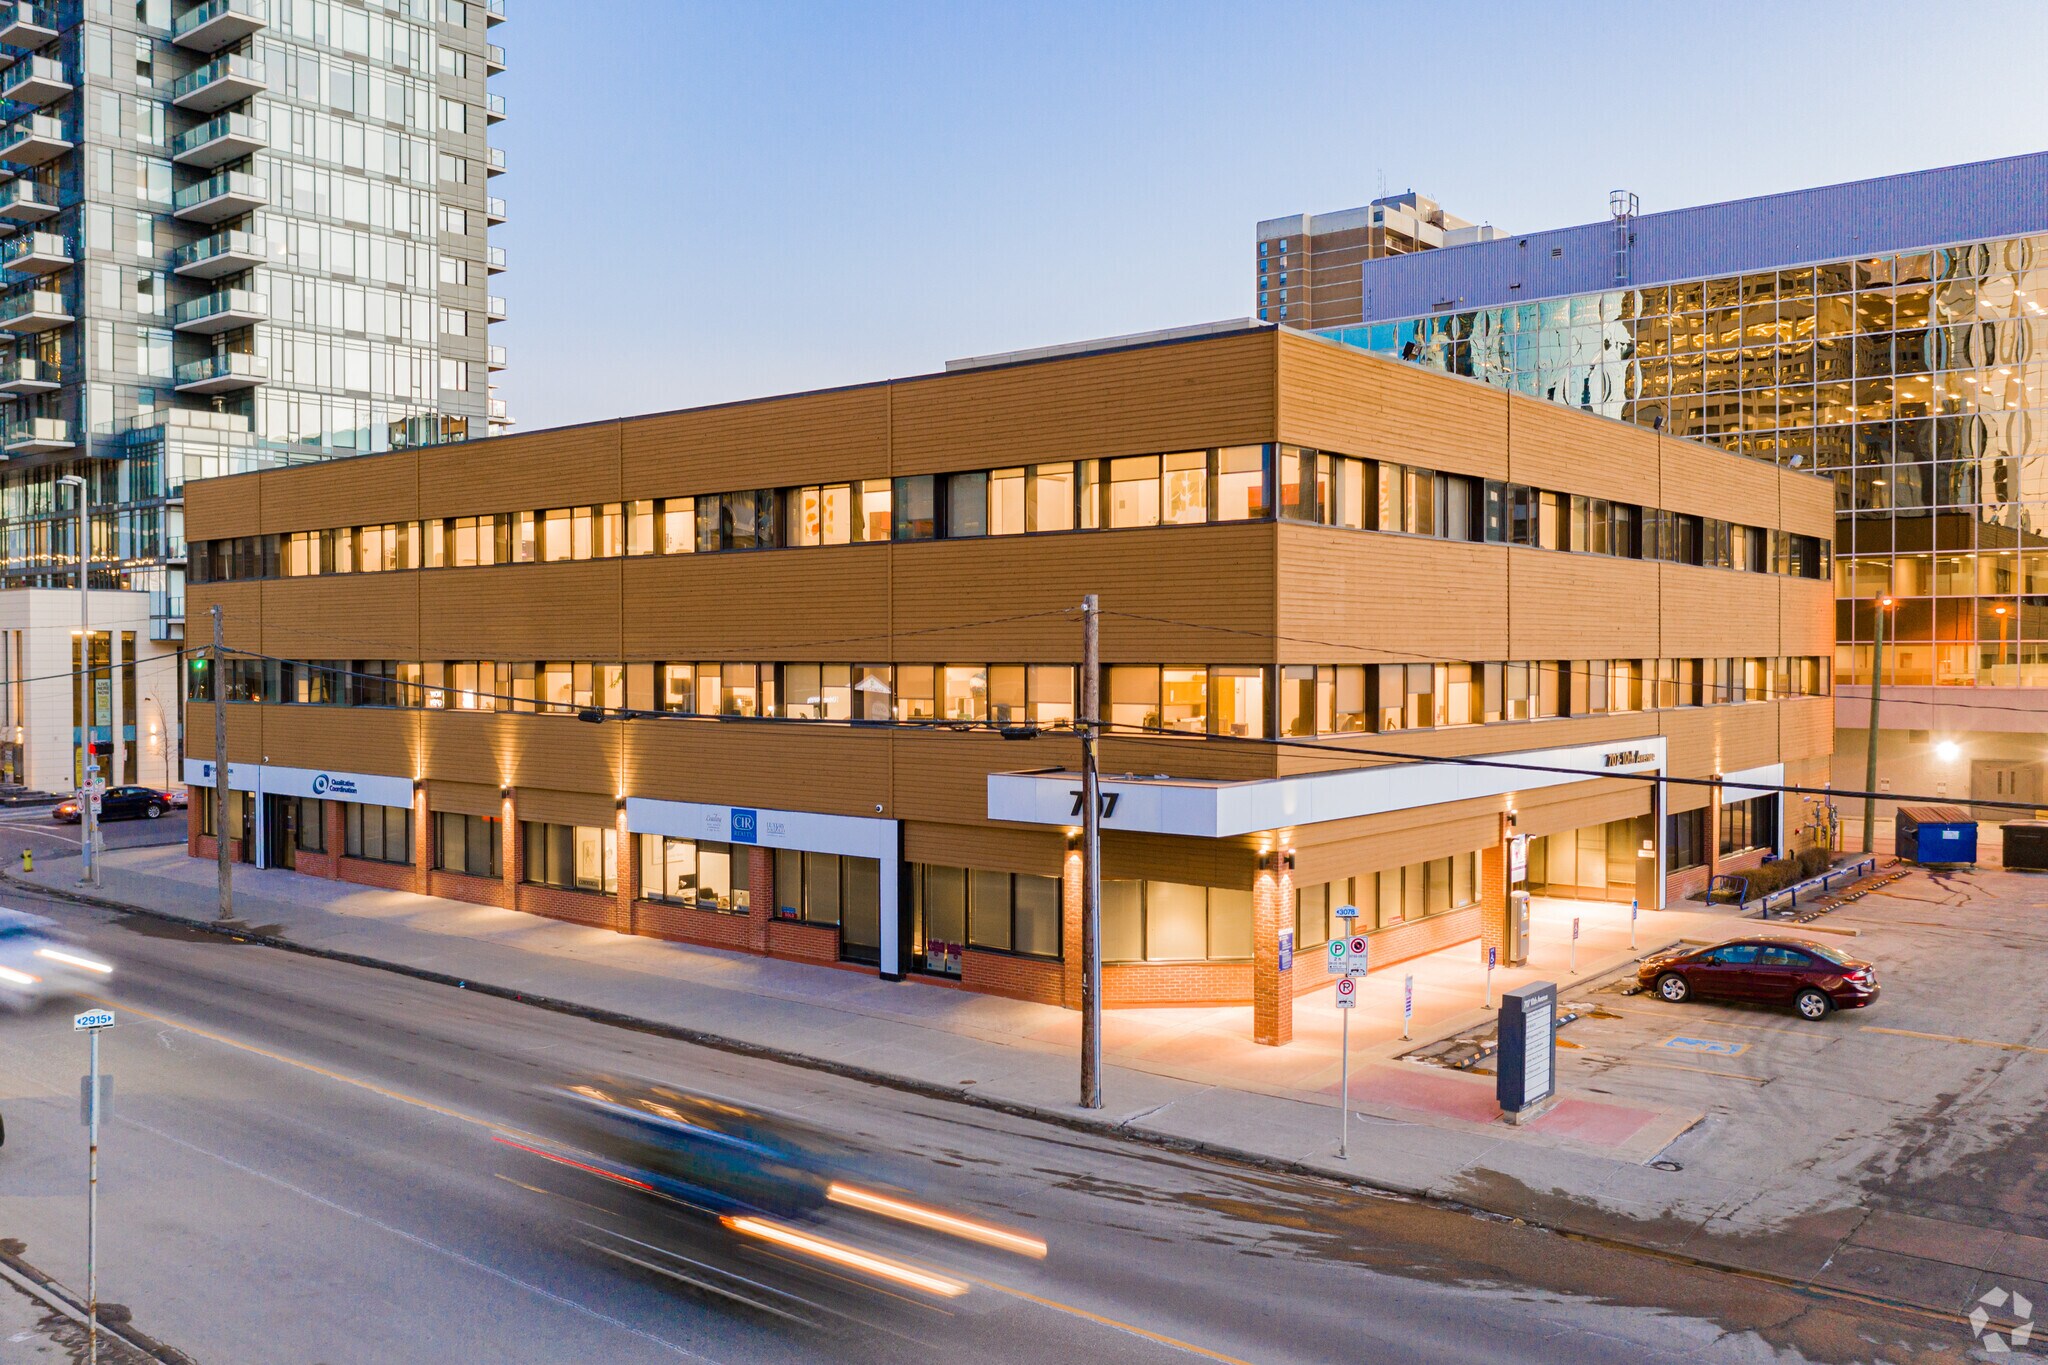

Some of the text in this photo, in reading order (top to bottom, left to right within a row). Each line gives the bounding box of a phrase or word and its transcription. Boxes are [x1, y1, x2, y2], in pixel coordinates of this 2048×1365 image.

[1634, 750, 1656, 763] Avenue
[331, 779, 355, 787] Qualitative
[329, 785, 358, 794] Coordination
[1070, 790, 1120, 818] 77
[734, 815, 752, 830] CIR
[1339, 908, 1355, 916] 3078
[1335, 944, 1342, 953] P
[82, 1015, 107, 1025] 2915
